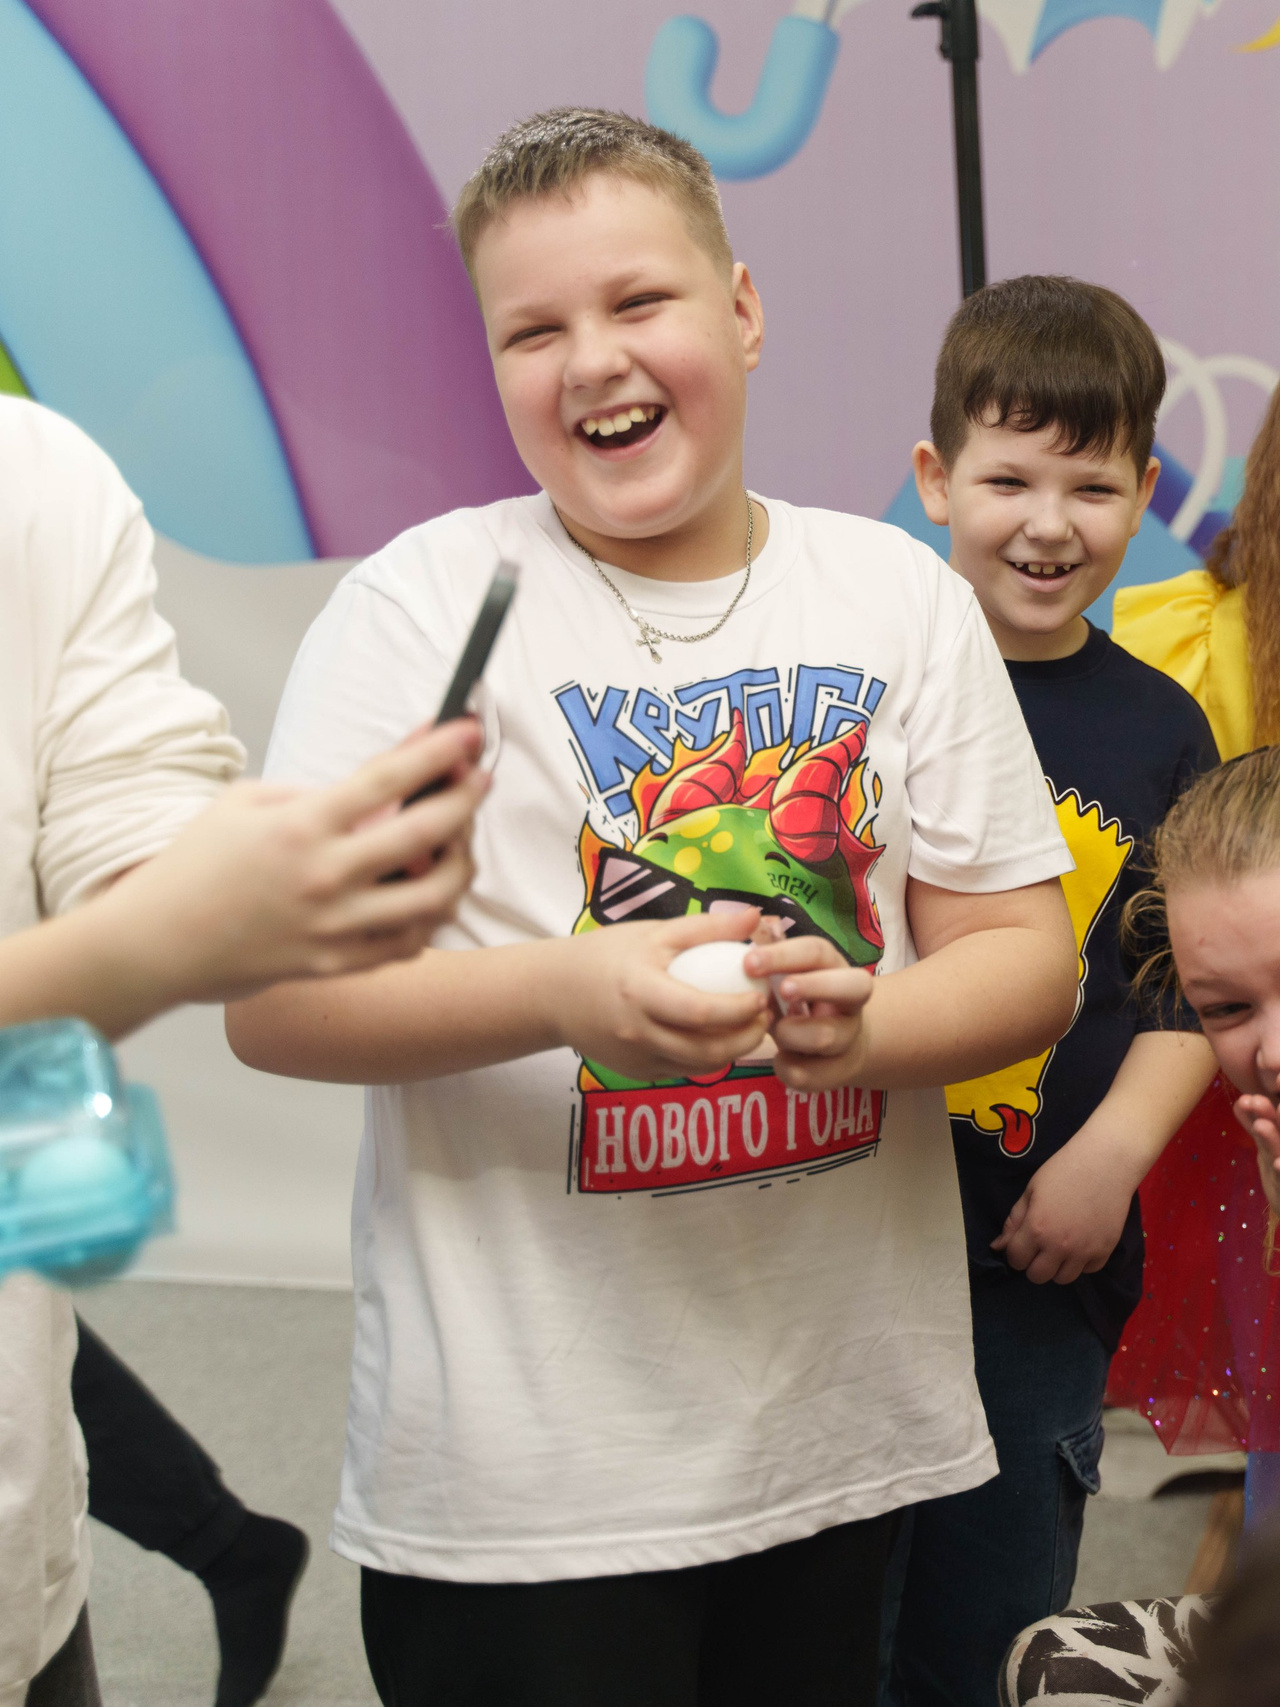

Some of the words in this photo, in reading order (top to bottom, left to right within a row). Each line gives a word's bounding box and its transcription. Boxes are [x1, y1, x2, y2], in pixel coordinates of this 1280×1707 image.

[767, 872, 818, 904] 2024
[595, 1091, 769, 1174] НОВОГО
[786, 1086, 873, 1149] ГОДА
